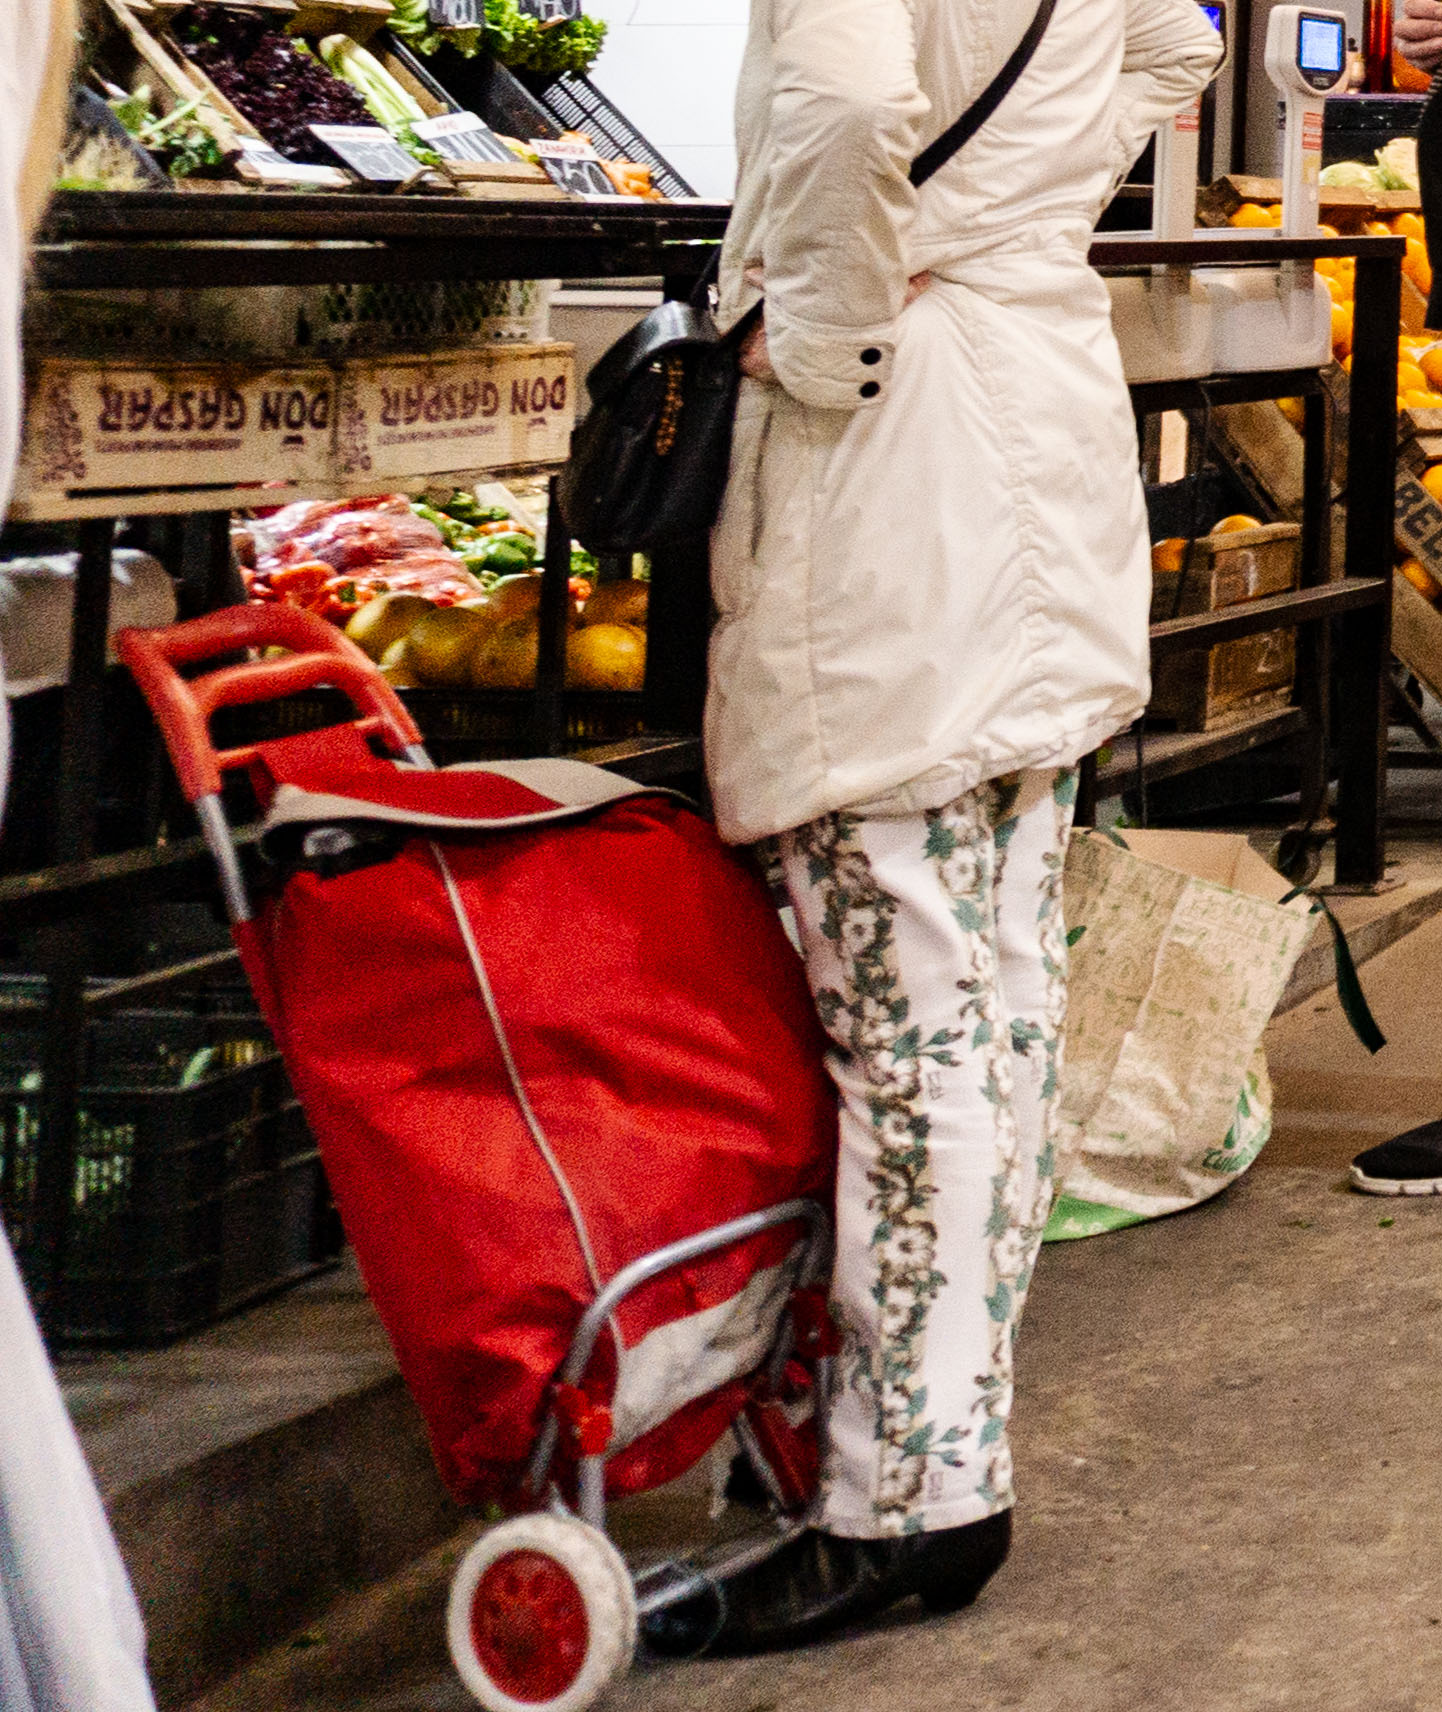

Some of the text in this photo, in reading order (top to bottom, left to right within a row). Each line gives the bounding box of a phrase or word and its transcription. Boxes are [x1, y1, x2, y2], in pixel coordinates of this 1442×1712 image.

[99, 387, 247, 433] GASPAR
[258, 390, 330, 432] DON
[379, 375, 566, 427] DON GASPAR
